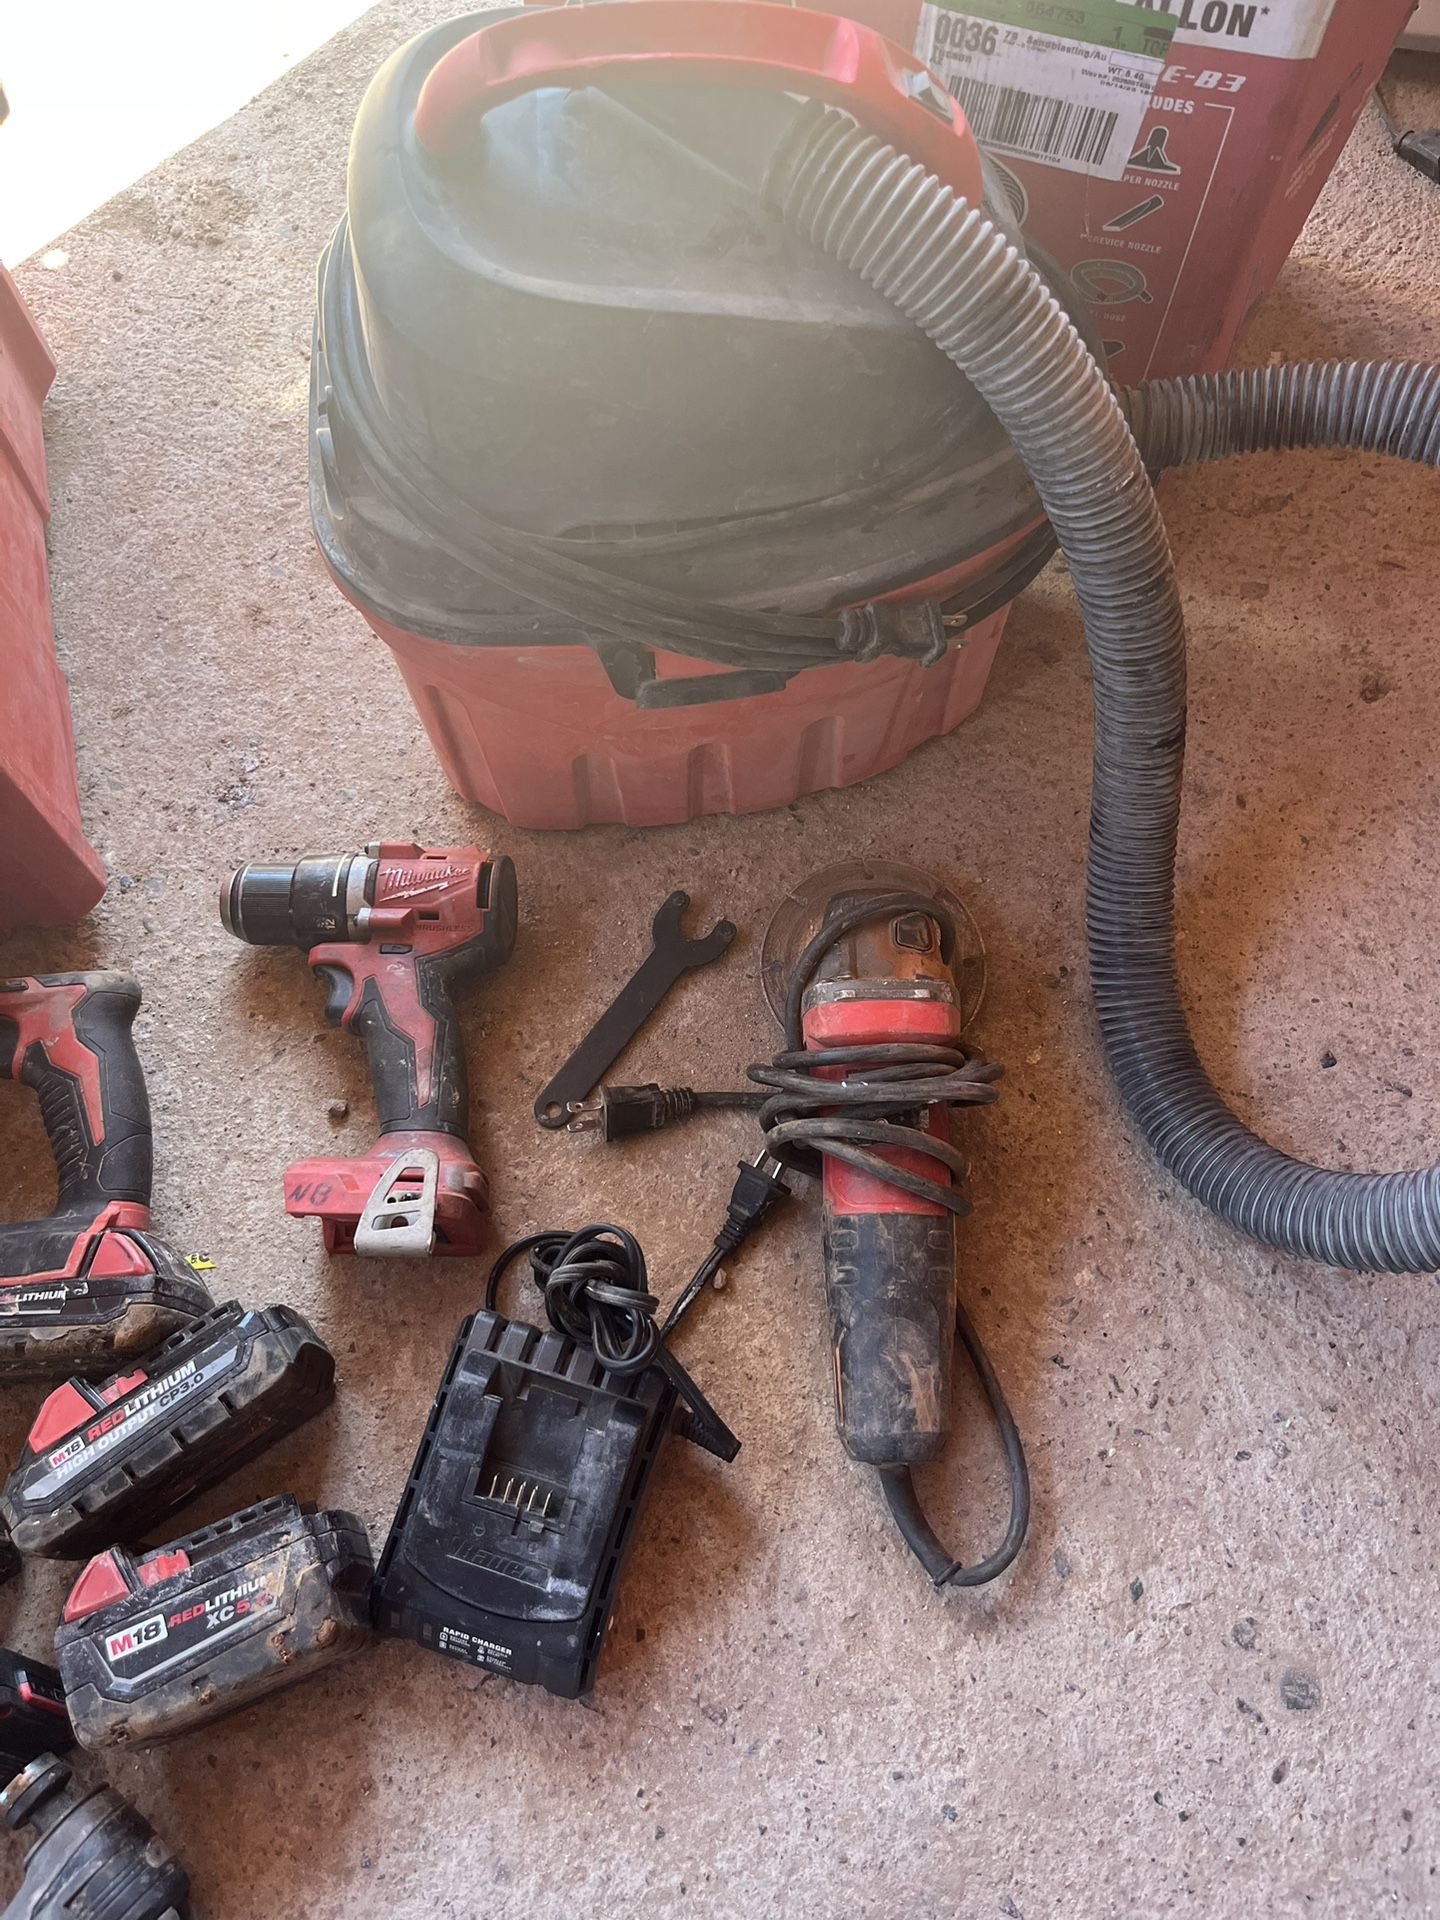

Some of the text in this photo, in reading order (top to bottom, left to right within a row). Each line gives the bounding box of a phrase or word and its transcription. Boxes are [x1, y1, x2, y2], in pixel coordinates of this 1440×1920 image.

[935, 14, 998, 56] 0036
[1144, 178, 1180, 191] NOZZLE
[1127, 241, 1162, 254] NOZZLE
[379, 865, 470, 893] Milwaukee
[52, 1359, 197, 1466] M18 REDLITHIUM
[56, 1372, 204, 1480] HIGH OUTPUT CP3.0
[110, 1621, 163, 1656] M18
[442, 1626, 470, 1641] RAPID
[471, 1636, 513, 1656] CHARGER
